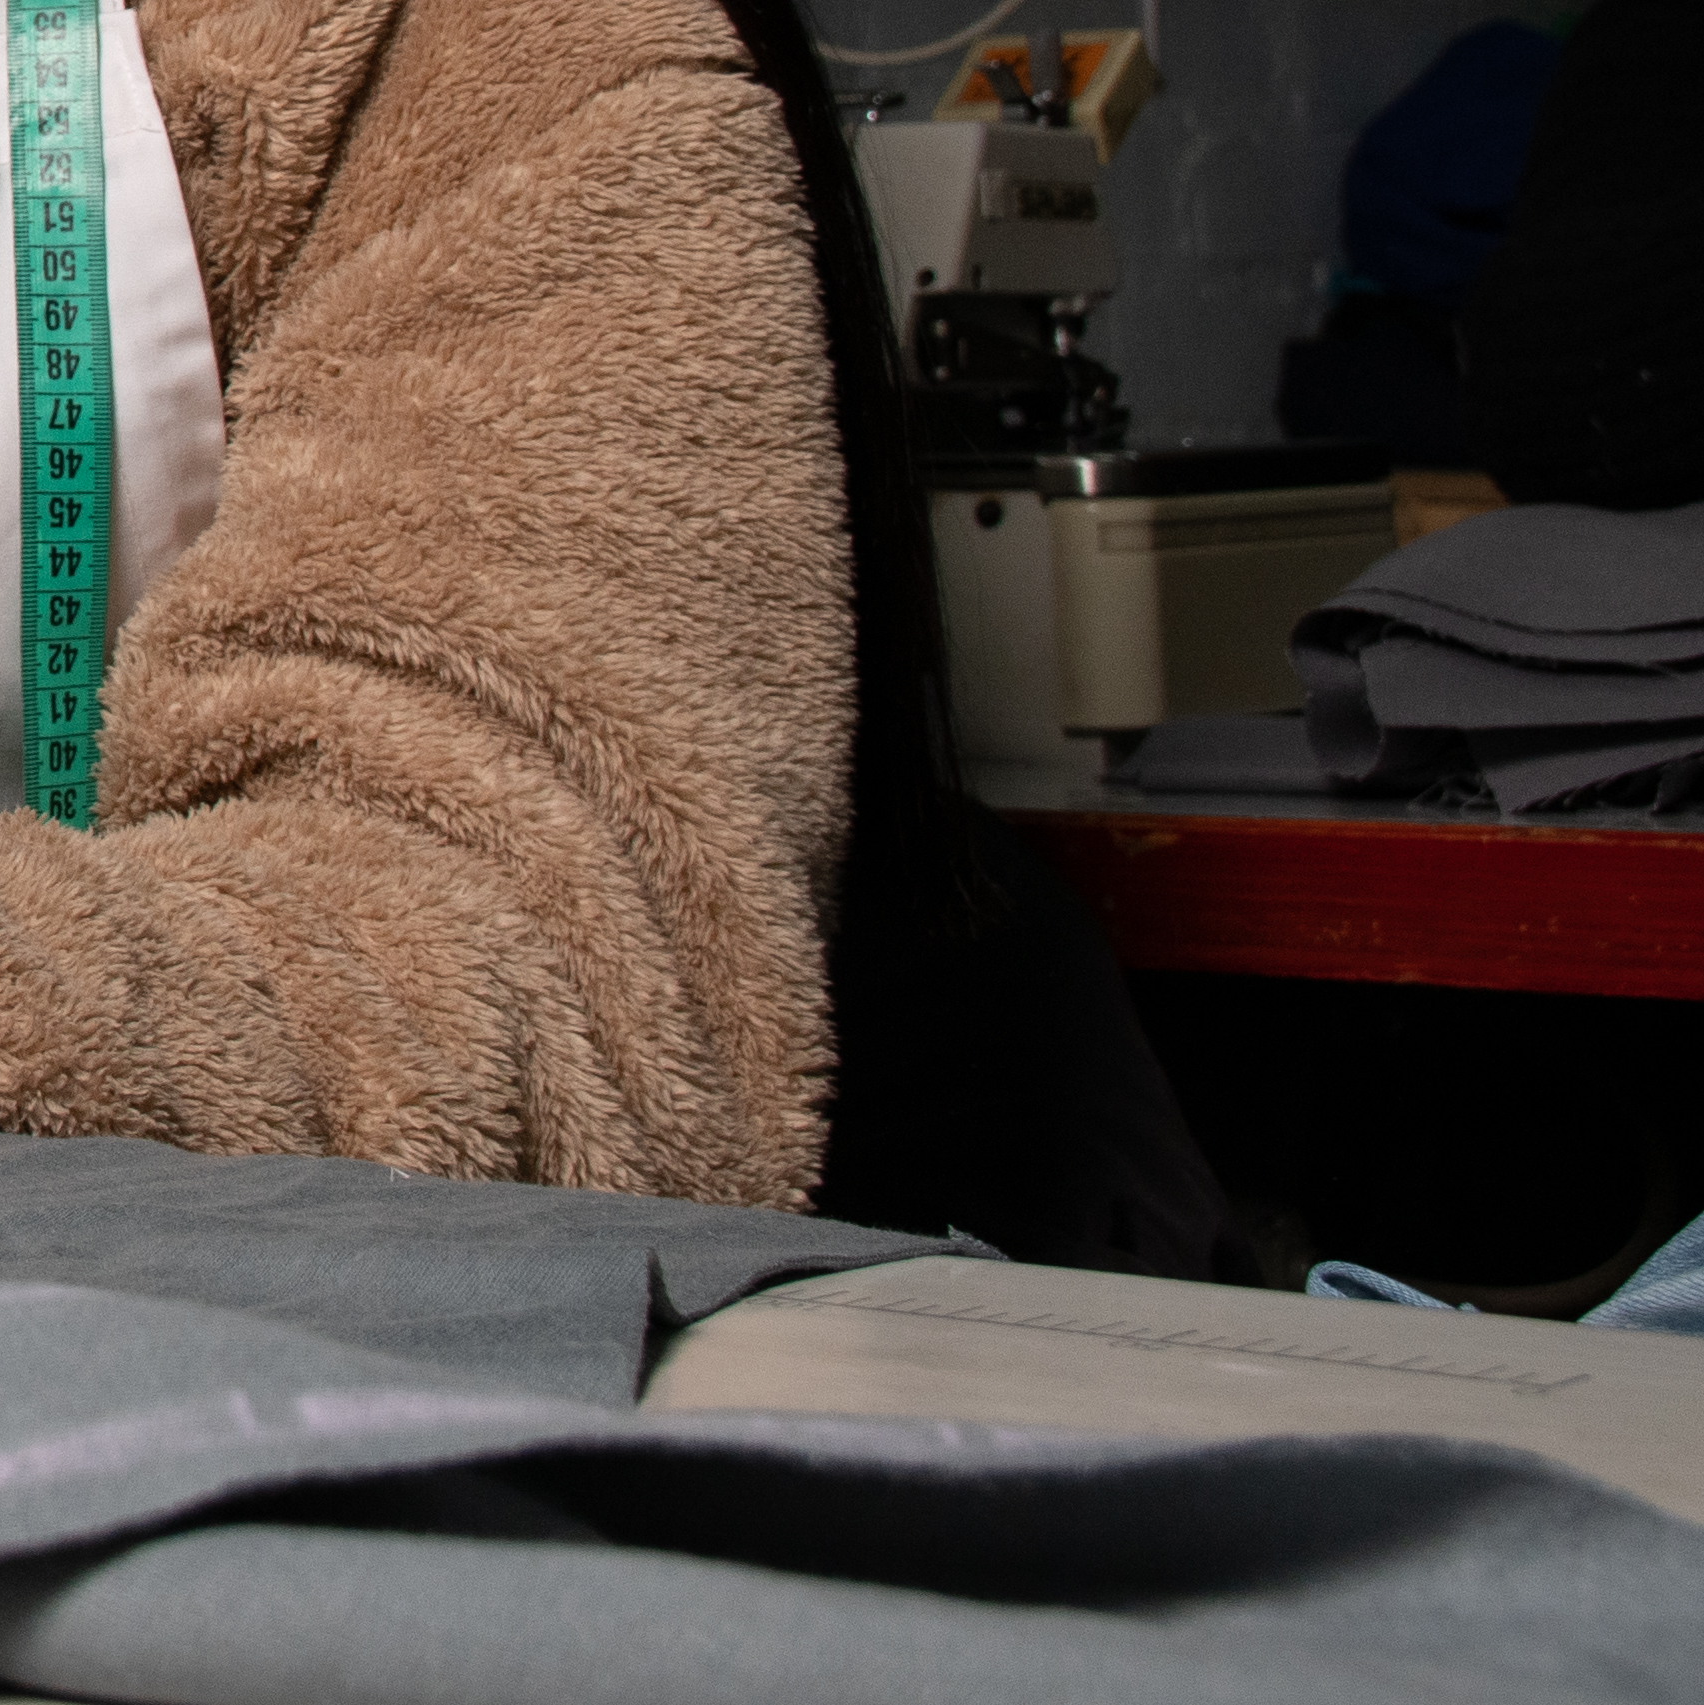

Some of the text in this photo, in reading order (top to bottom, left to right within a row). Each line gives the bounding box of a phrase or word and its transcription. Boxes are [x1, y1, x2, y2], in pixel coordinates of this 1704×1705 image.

[43, 201, 74, 233] 51
[42, 249, 76, 282] 50
[44, 299, 78, 331] 49
[46, 348, 81, 380] 48
[48, 397, 82, 430] 47
[49, 447, 83, 480] 46
[48, 496, 82, 529] 45
[49, 546, 82, 578] 44
[49, 595, 81, 627] 43
[48, 643, 79, 675] 42
[49, 691, 78, 724] 41
[49, 741, 78, 773] 40
[49, 788, 77, 820] 39
